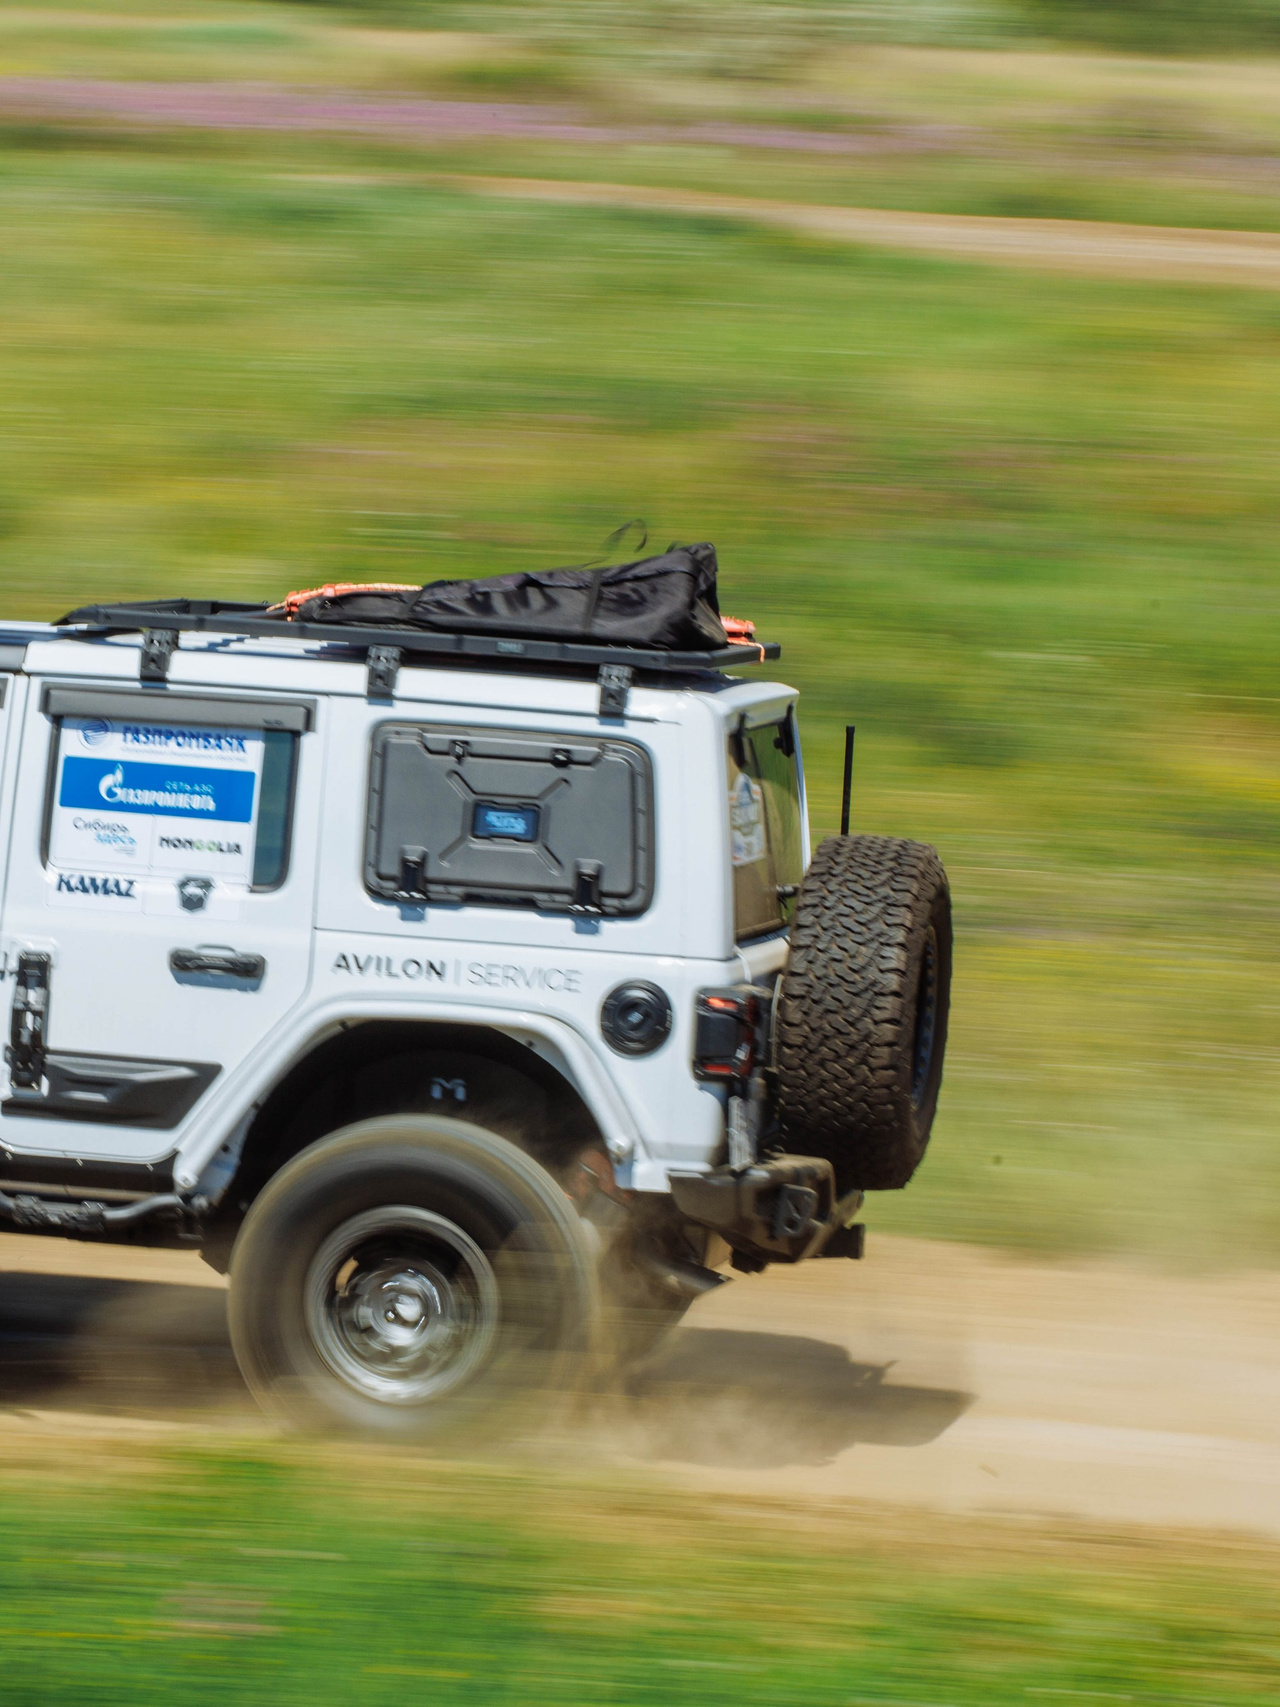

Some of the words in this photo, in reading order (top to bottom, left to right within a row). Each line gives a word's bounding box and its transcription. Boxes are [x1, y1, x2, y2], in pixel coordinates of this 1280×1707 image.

[56, 872, 139, 899] KAMAZ
[331, 951, 447, 983] AVILON
[467, 961, 584, 994] SERVICE
